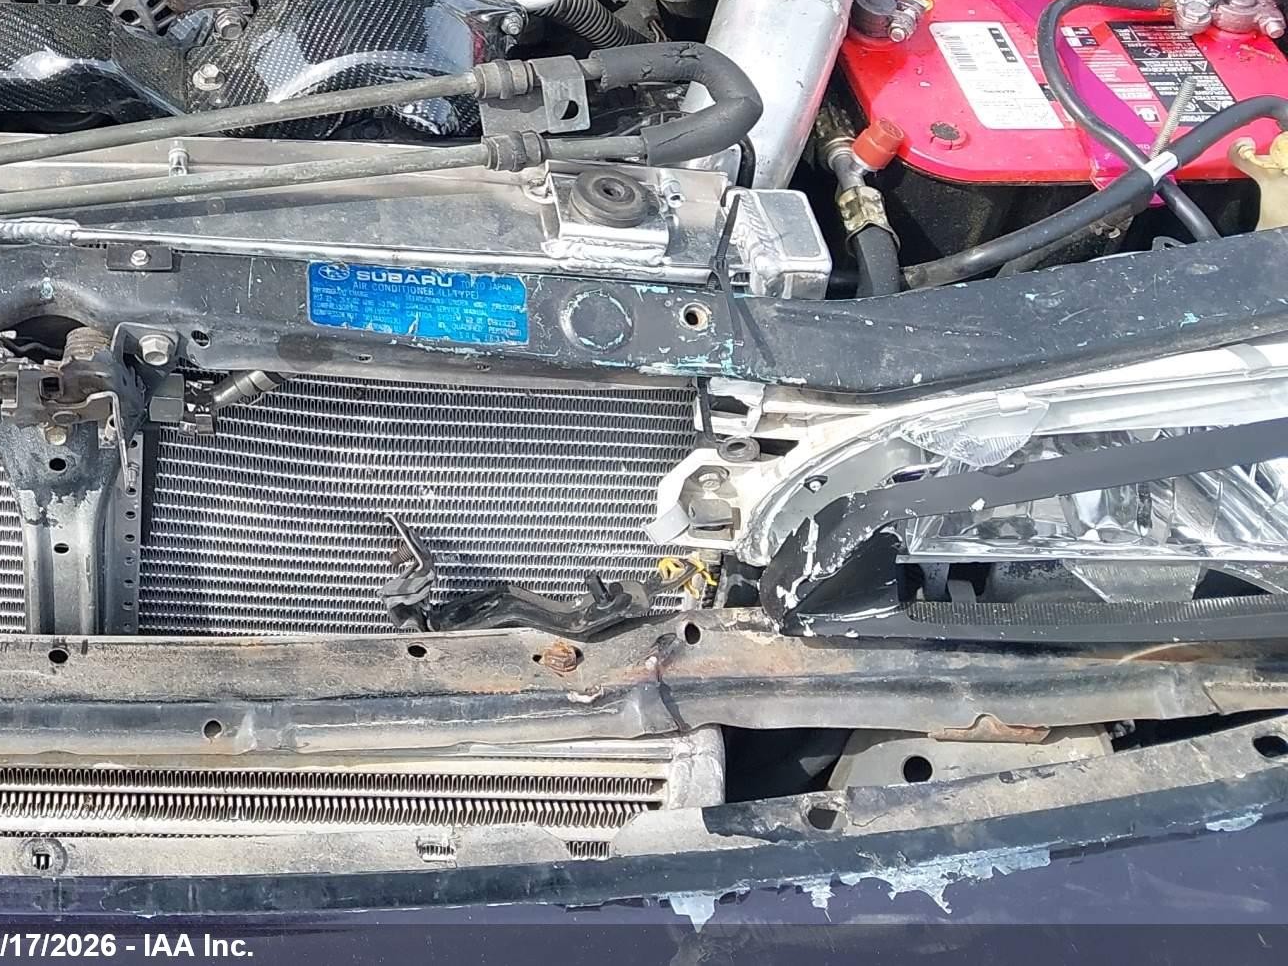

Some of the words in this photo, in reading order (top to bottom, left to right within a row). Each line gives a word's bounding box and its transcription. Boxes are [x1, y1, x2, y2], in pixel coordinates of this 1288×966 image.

[356, 270, 452, 287] SUBARU
[353, 281, 367, 291] AIR
[372, 283, 434, 296] CONDITIONER
[489, 282, 512, 291] JAPAN
